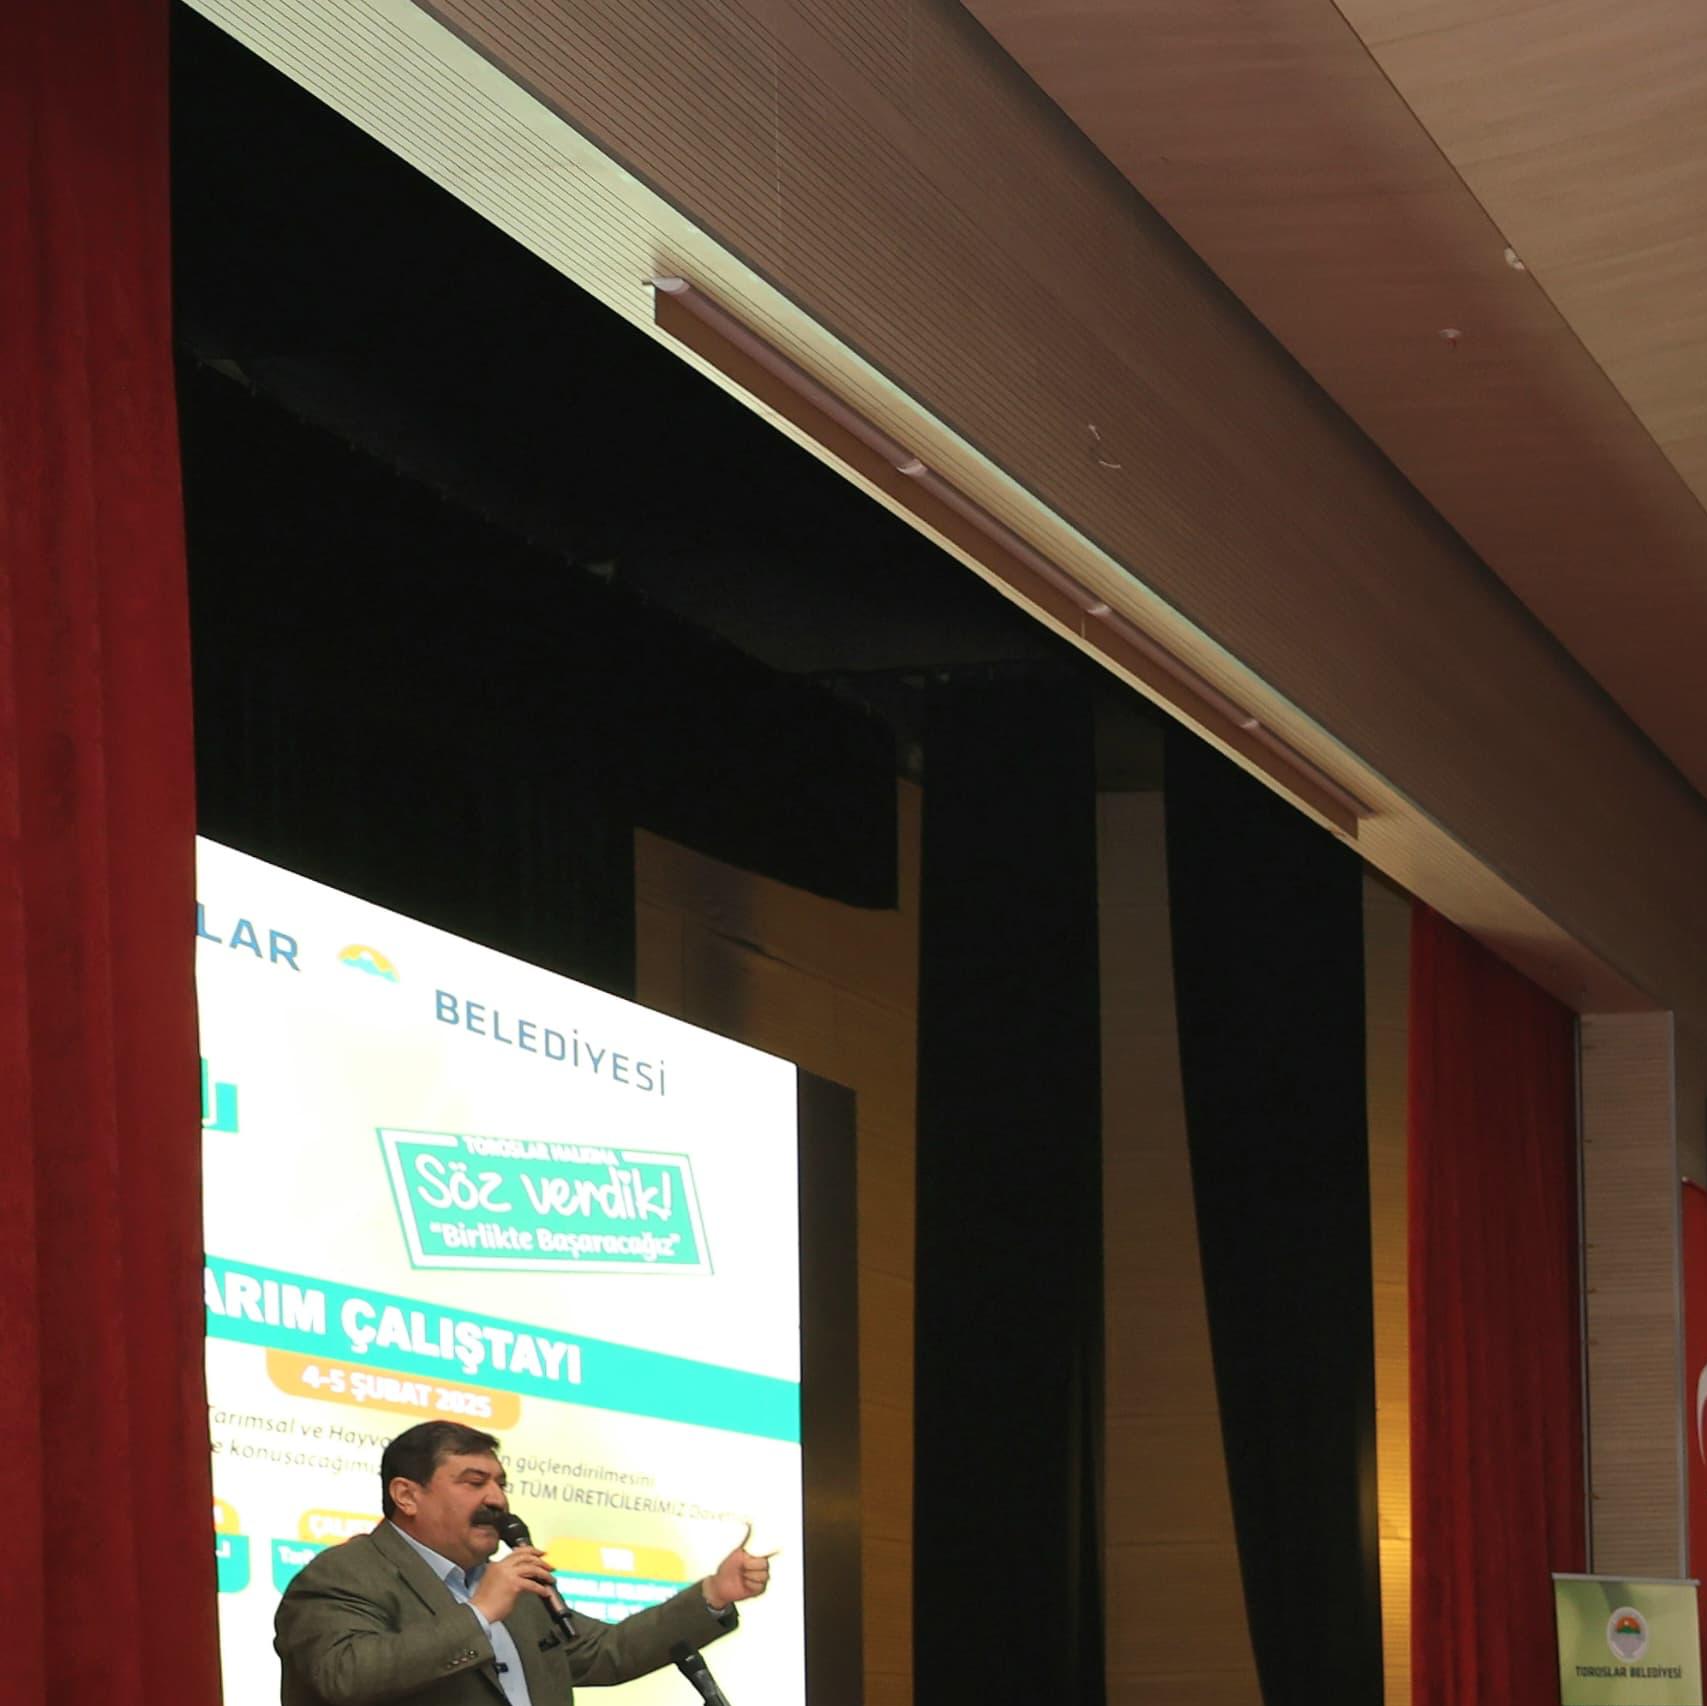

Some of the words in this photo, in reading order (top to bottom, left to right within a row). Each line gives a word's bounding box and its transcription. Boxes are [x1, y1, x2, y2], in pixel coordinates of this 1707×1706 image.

[436, 989, 665, 1097] BELEDİYESİ
[415, 1152, 512, 1212] Söz
[520, 1164, 672, 1221] verdik!
[340, 1298, 582, 1385] ÇALIŞTAYI
[210, 1405, 295, 1434] arımsal
[301, 1424, 323, 1439] ve
[302, 1365, 345, 1394] 4-5
[350, 1372, 433, 1402] ŞUBAT
[434, 1387, 494, 1418] 2025
[519, 1477, 558, 1501] TÜM
